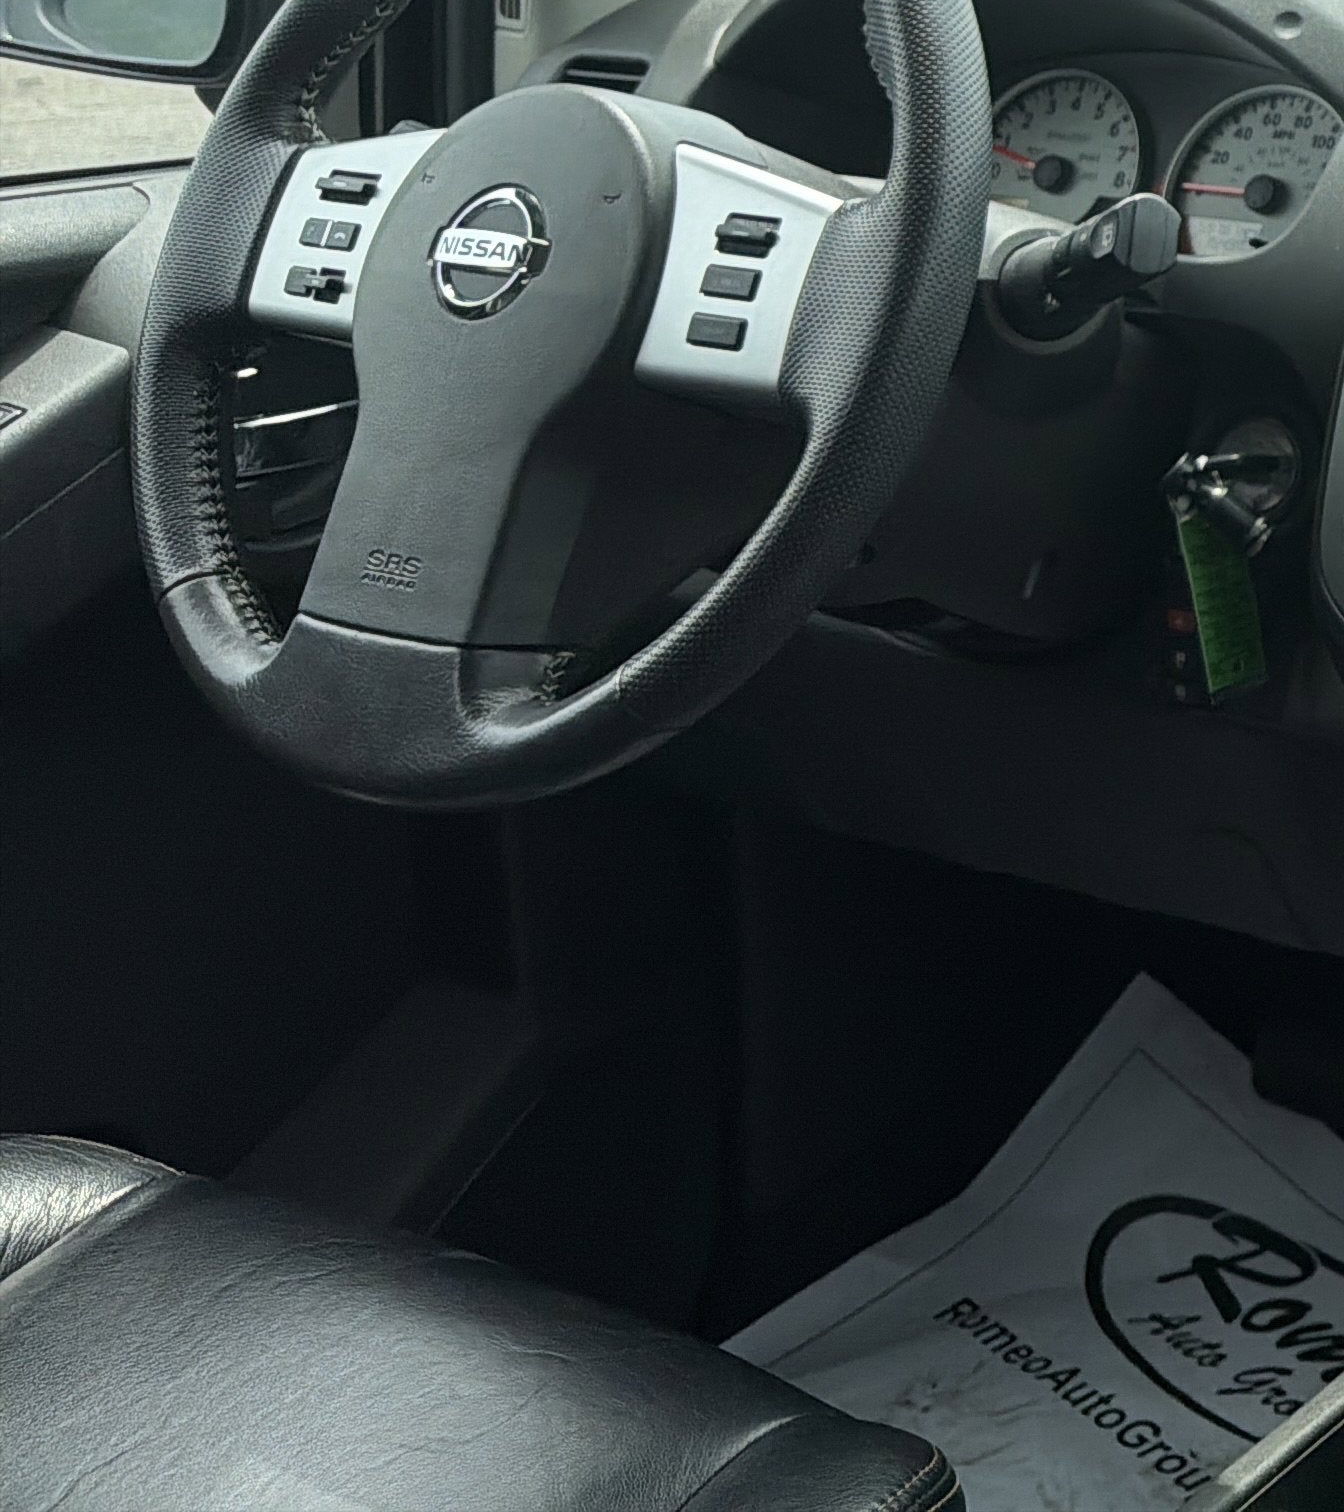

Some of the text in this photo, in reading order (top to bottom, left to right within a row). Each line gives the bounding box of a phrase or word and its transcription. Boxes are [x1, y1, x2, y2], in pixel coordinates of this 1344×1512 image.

[1262, 112, 1283, 127] 60
[1294, 115, 1314, 130] 80
[1233, 125, 1254, 141] 40
[1310, 134, 1336, 151] 100
[1210, 150, 1231, 165] 20
[439, 236, 525, 262] NISSAN
[366, 548, 423, 575] SRS
[1127, 1312, 1303, 1417] Auto Gro
